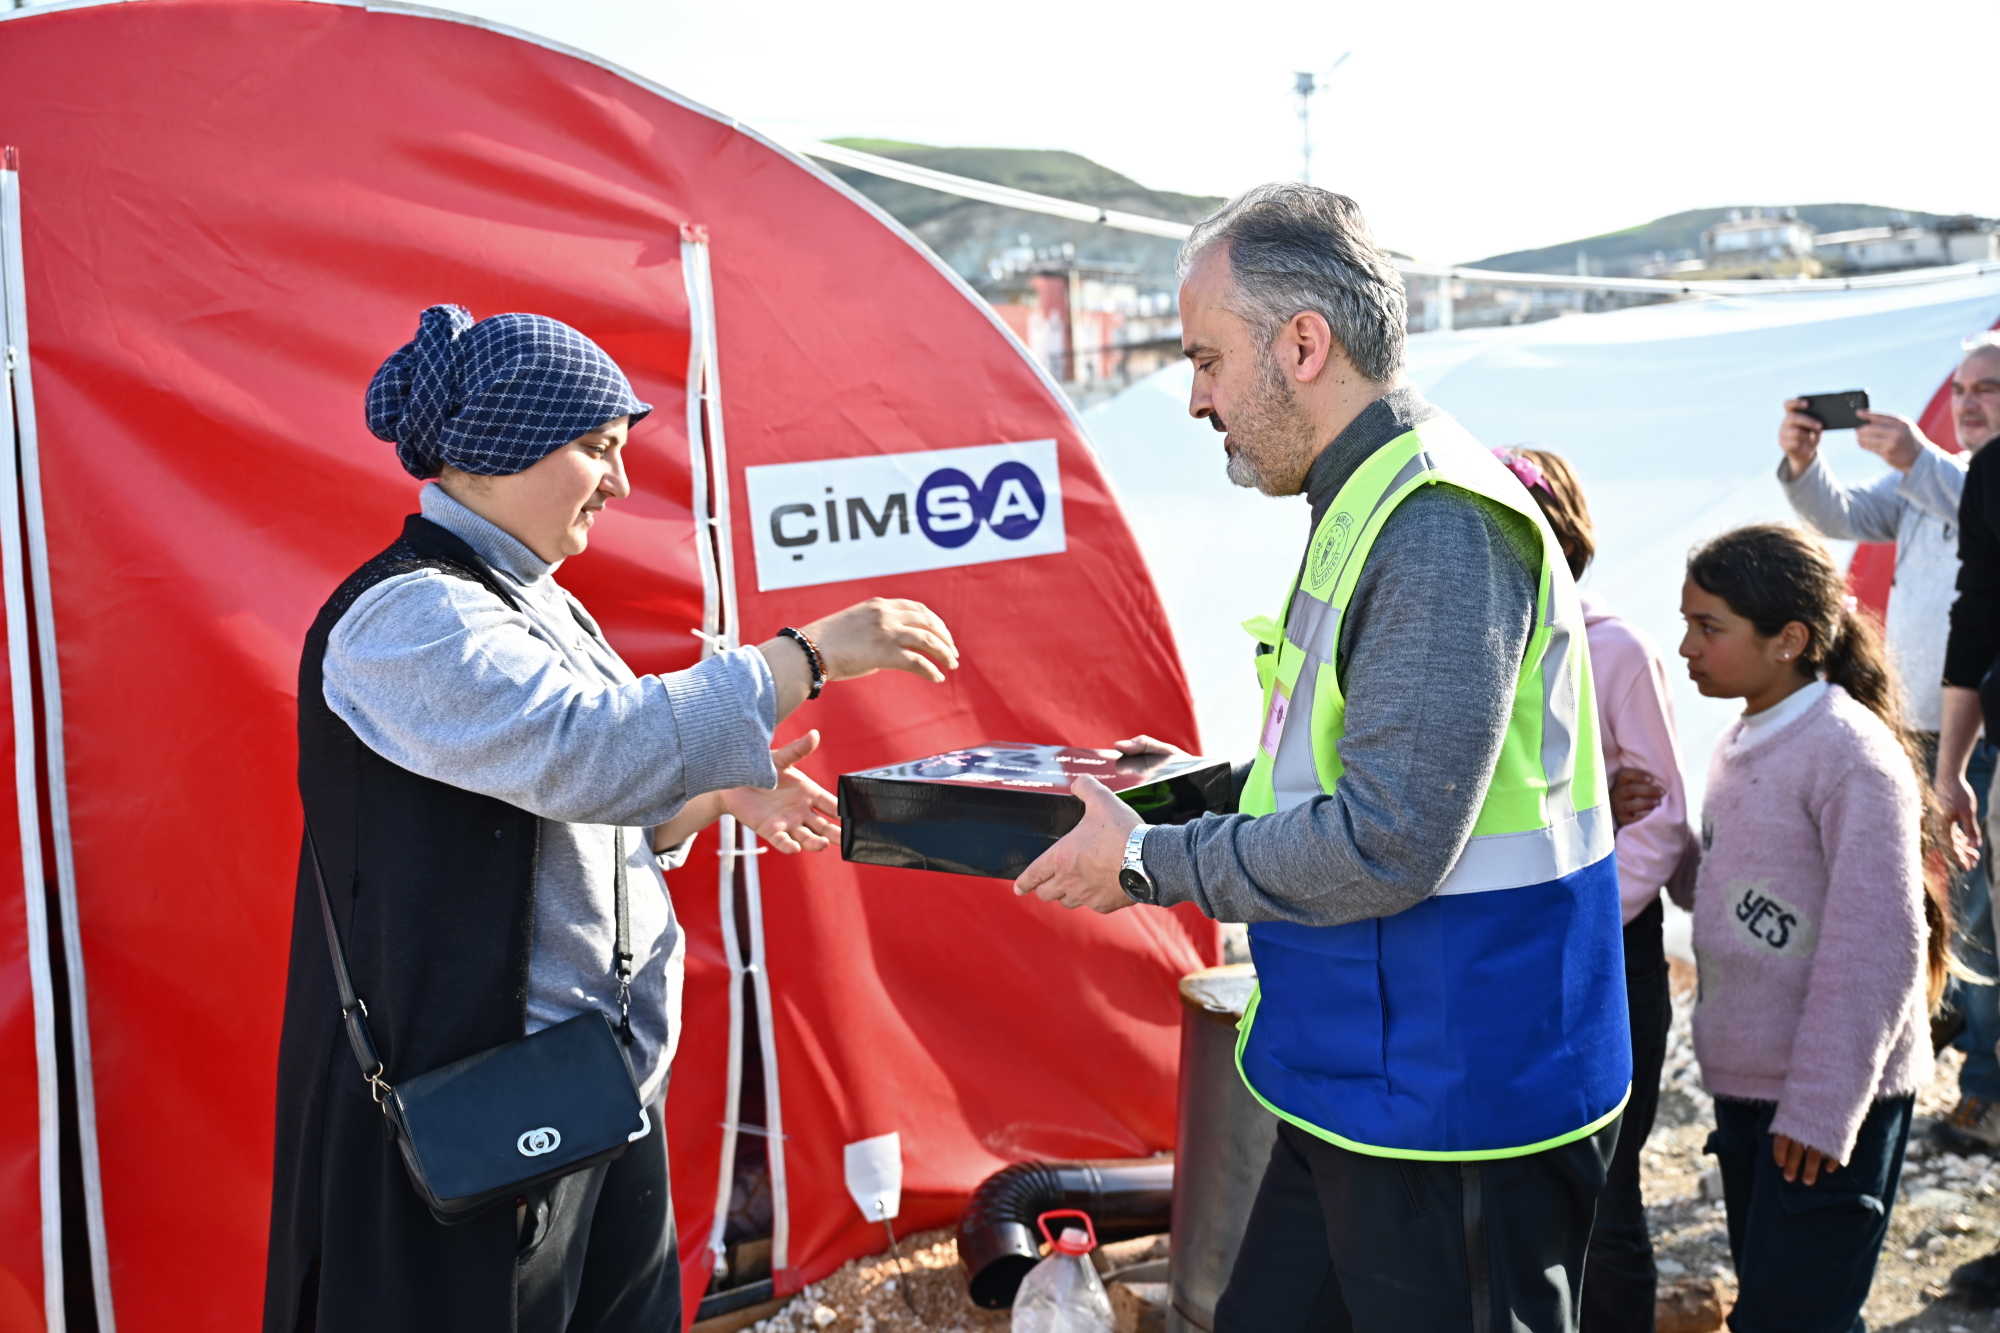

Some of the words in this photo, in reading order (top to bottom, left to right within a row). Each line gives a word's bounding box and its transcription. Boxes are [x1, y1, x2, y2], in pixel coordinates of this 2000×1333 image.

[770, 476, 1041, 561] ÇİMSA
[1335, 514, 1352, 531] BURSA
[1736, 888, 1797, 949] YES
